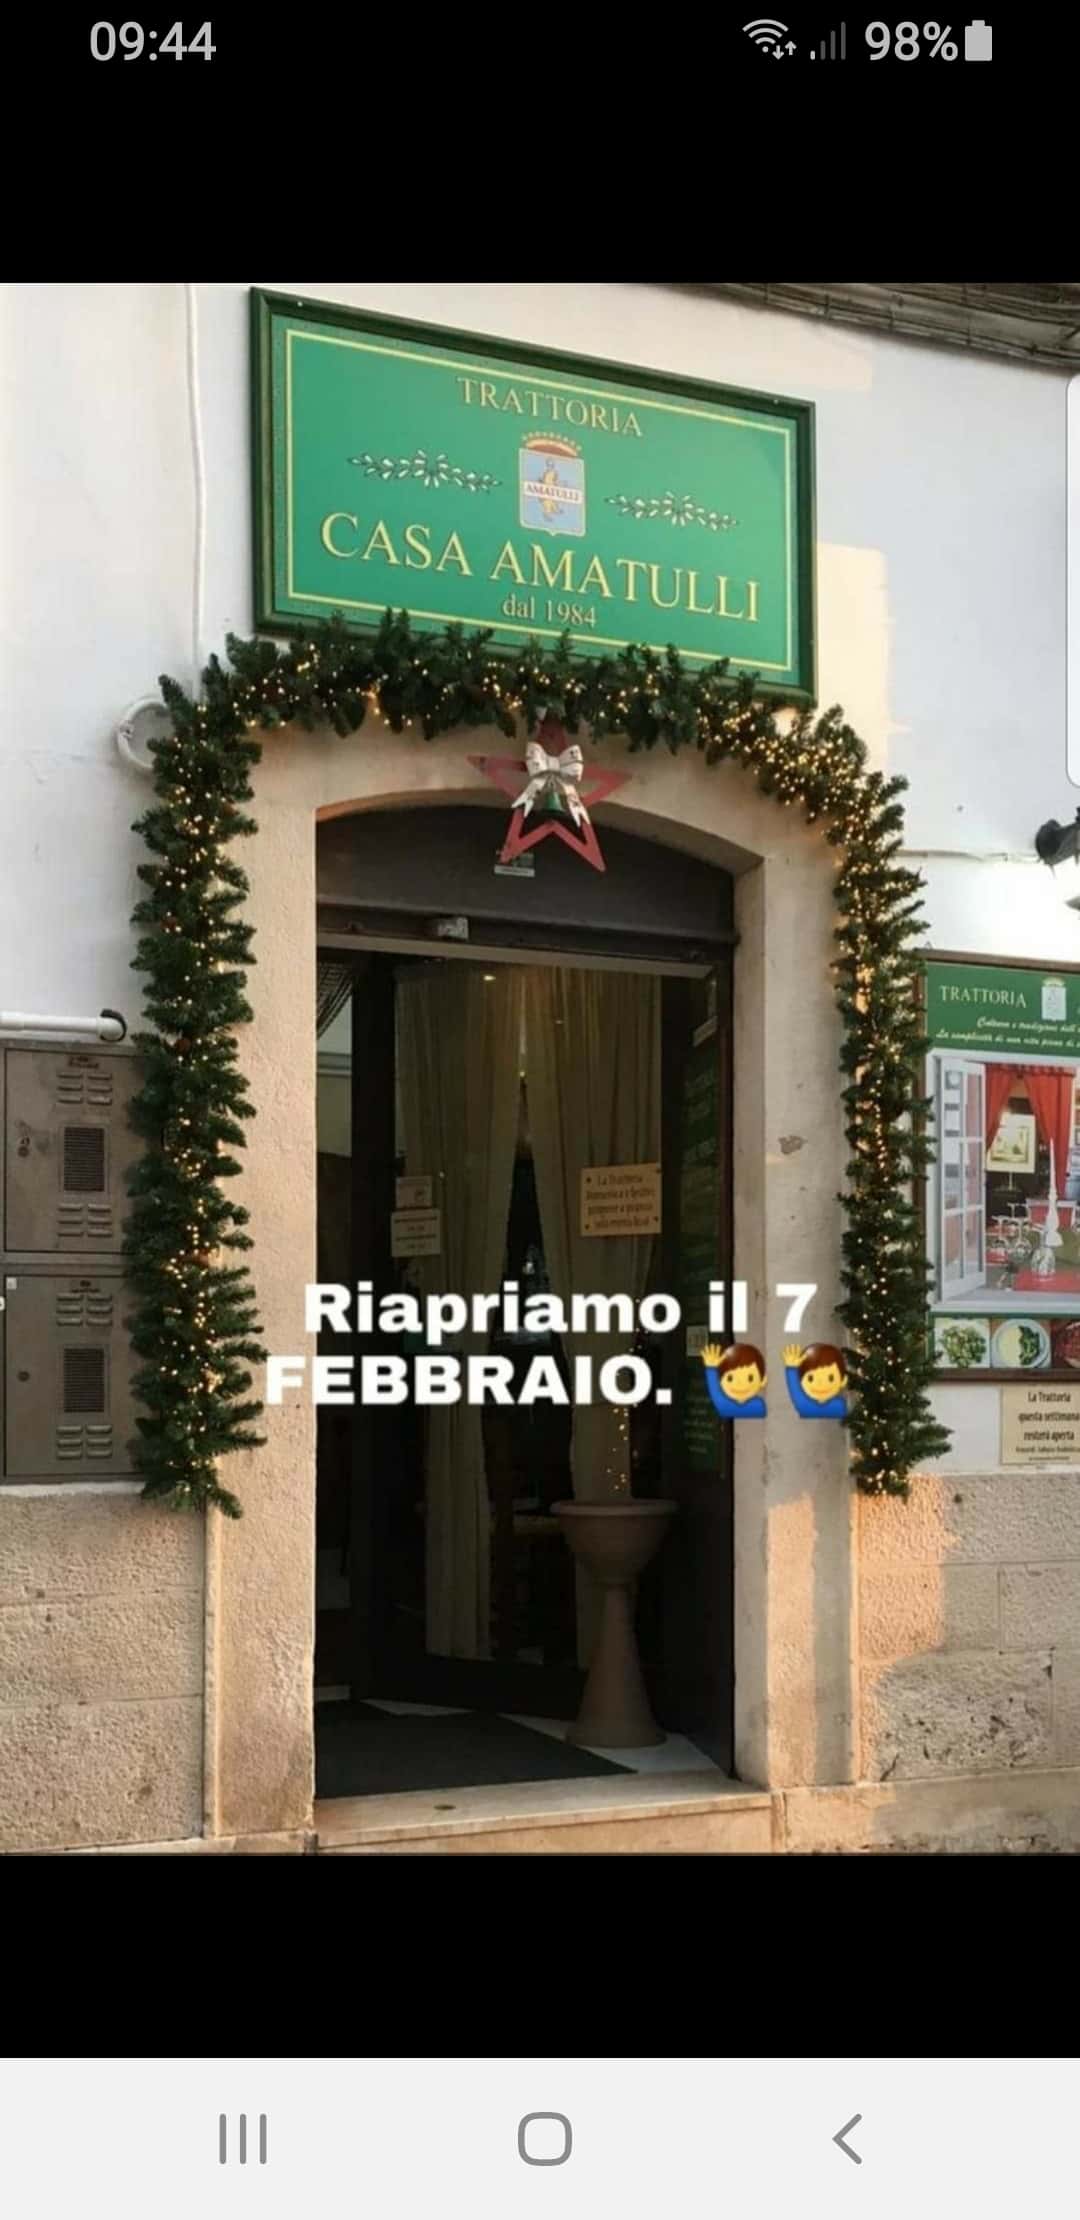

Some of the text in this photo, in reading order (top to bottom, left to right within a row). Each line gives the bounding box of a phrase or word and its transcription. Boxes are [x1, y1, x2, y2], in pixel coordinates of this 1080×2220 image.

[457, 376, 643, 437] TRATTORIA
[527, 484, 579, 501] AMATULLI
[321, 511, 760, 622] CASA AMATULLI
[503, 593, 597, 627] dal 1984
[940, 985, 1027, 1009] TRATTORIA
[1028, 1391, 1037, 1402] La
